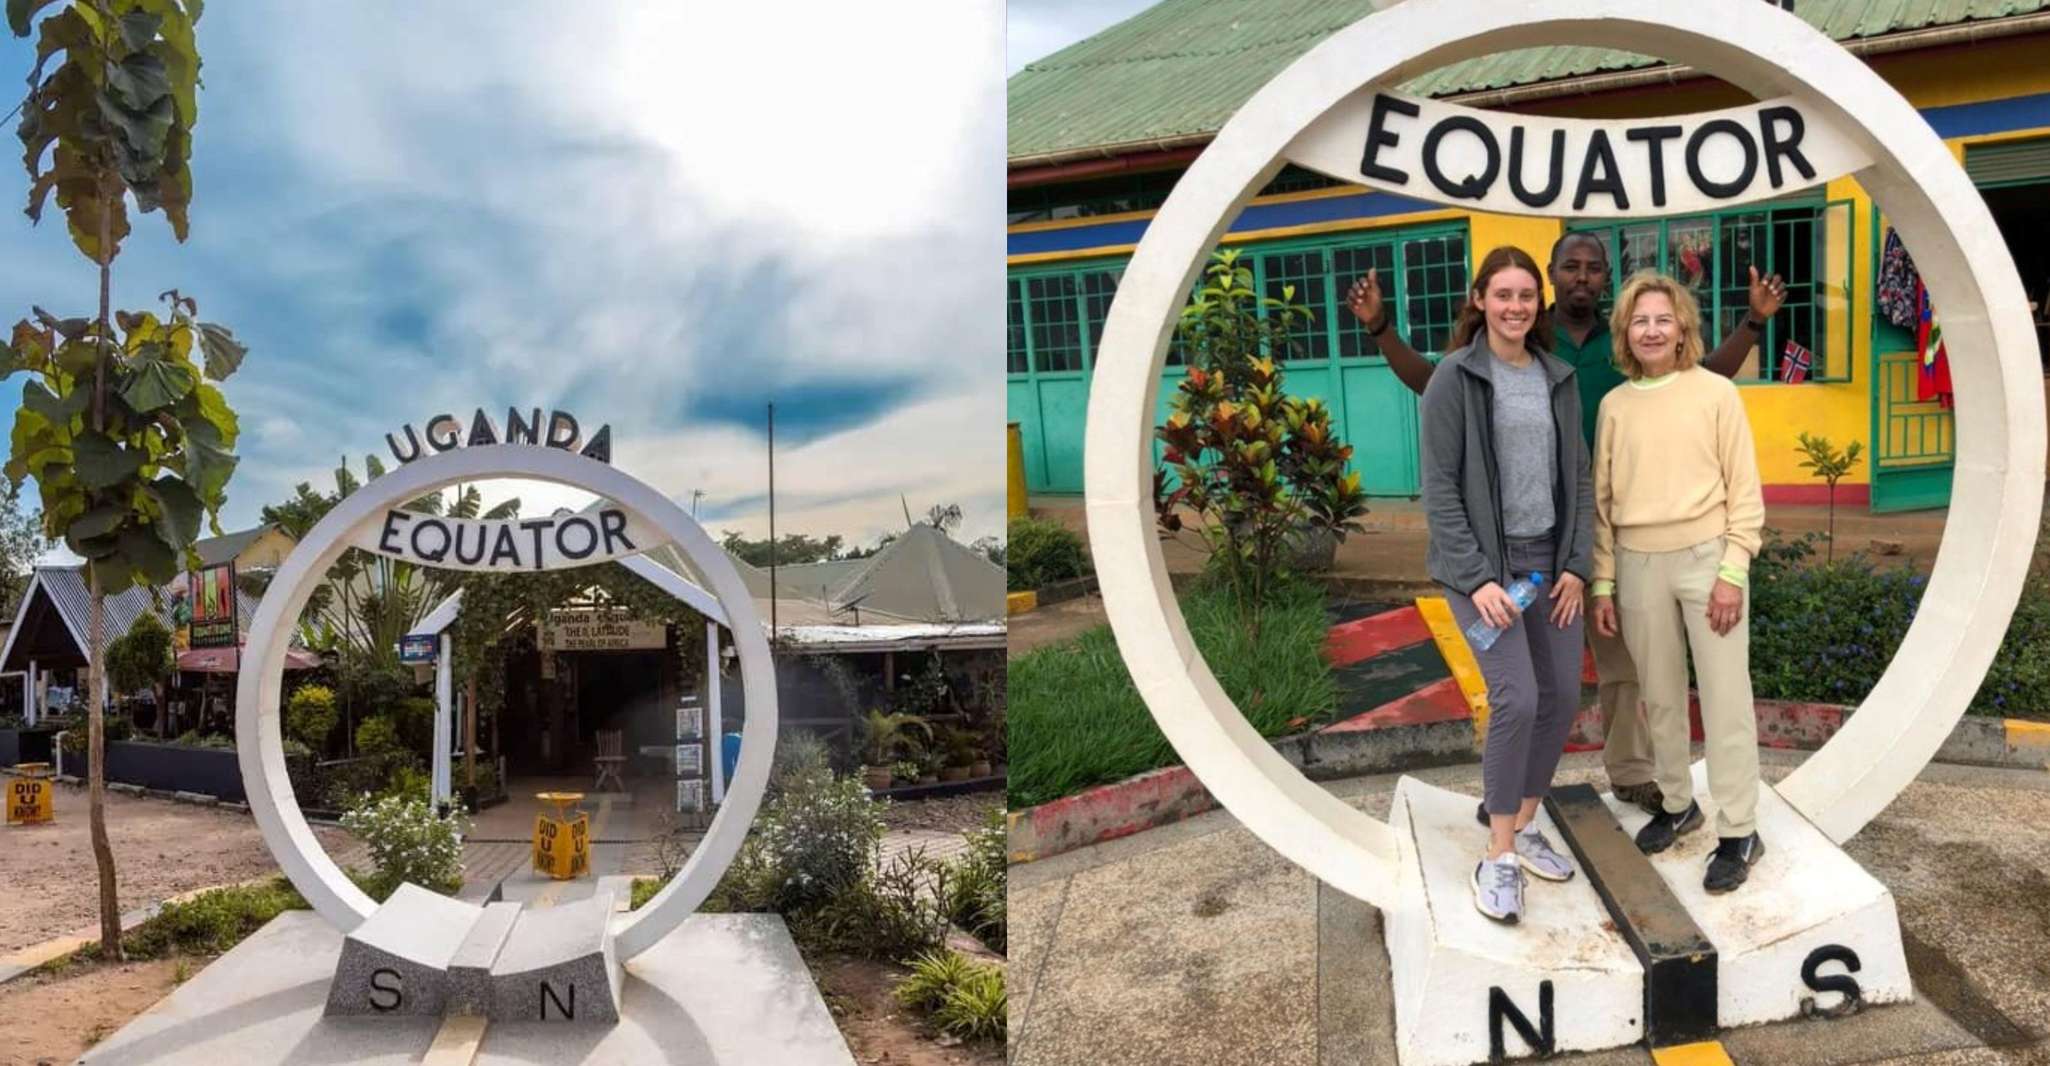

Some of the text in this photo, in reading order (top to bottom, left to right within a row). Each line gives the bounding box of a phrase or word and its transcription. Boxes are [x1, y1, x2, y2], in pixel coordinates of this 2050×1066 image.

[1360, 93, 1817, 210] EQUATOR
[385, 406, 611, 463] UGANDA
[379, 509, 636, 569] EQUATOR
[15, 783, 42, 794] DID
[20, 795, 35, 805] U
[539, 819, 557, 838] DID
[541, 836, 552, 852] U
[572, 820, 585, 839] DID
[575, 837, 583, 853] U
[369, 968, 402, 1011] S
[540, 981, 575, 1020] N
[1801, 944, 1862, 1020] S
[1488, 980, 1555, 1063] N
